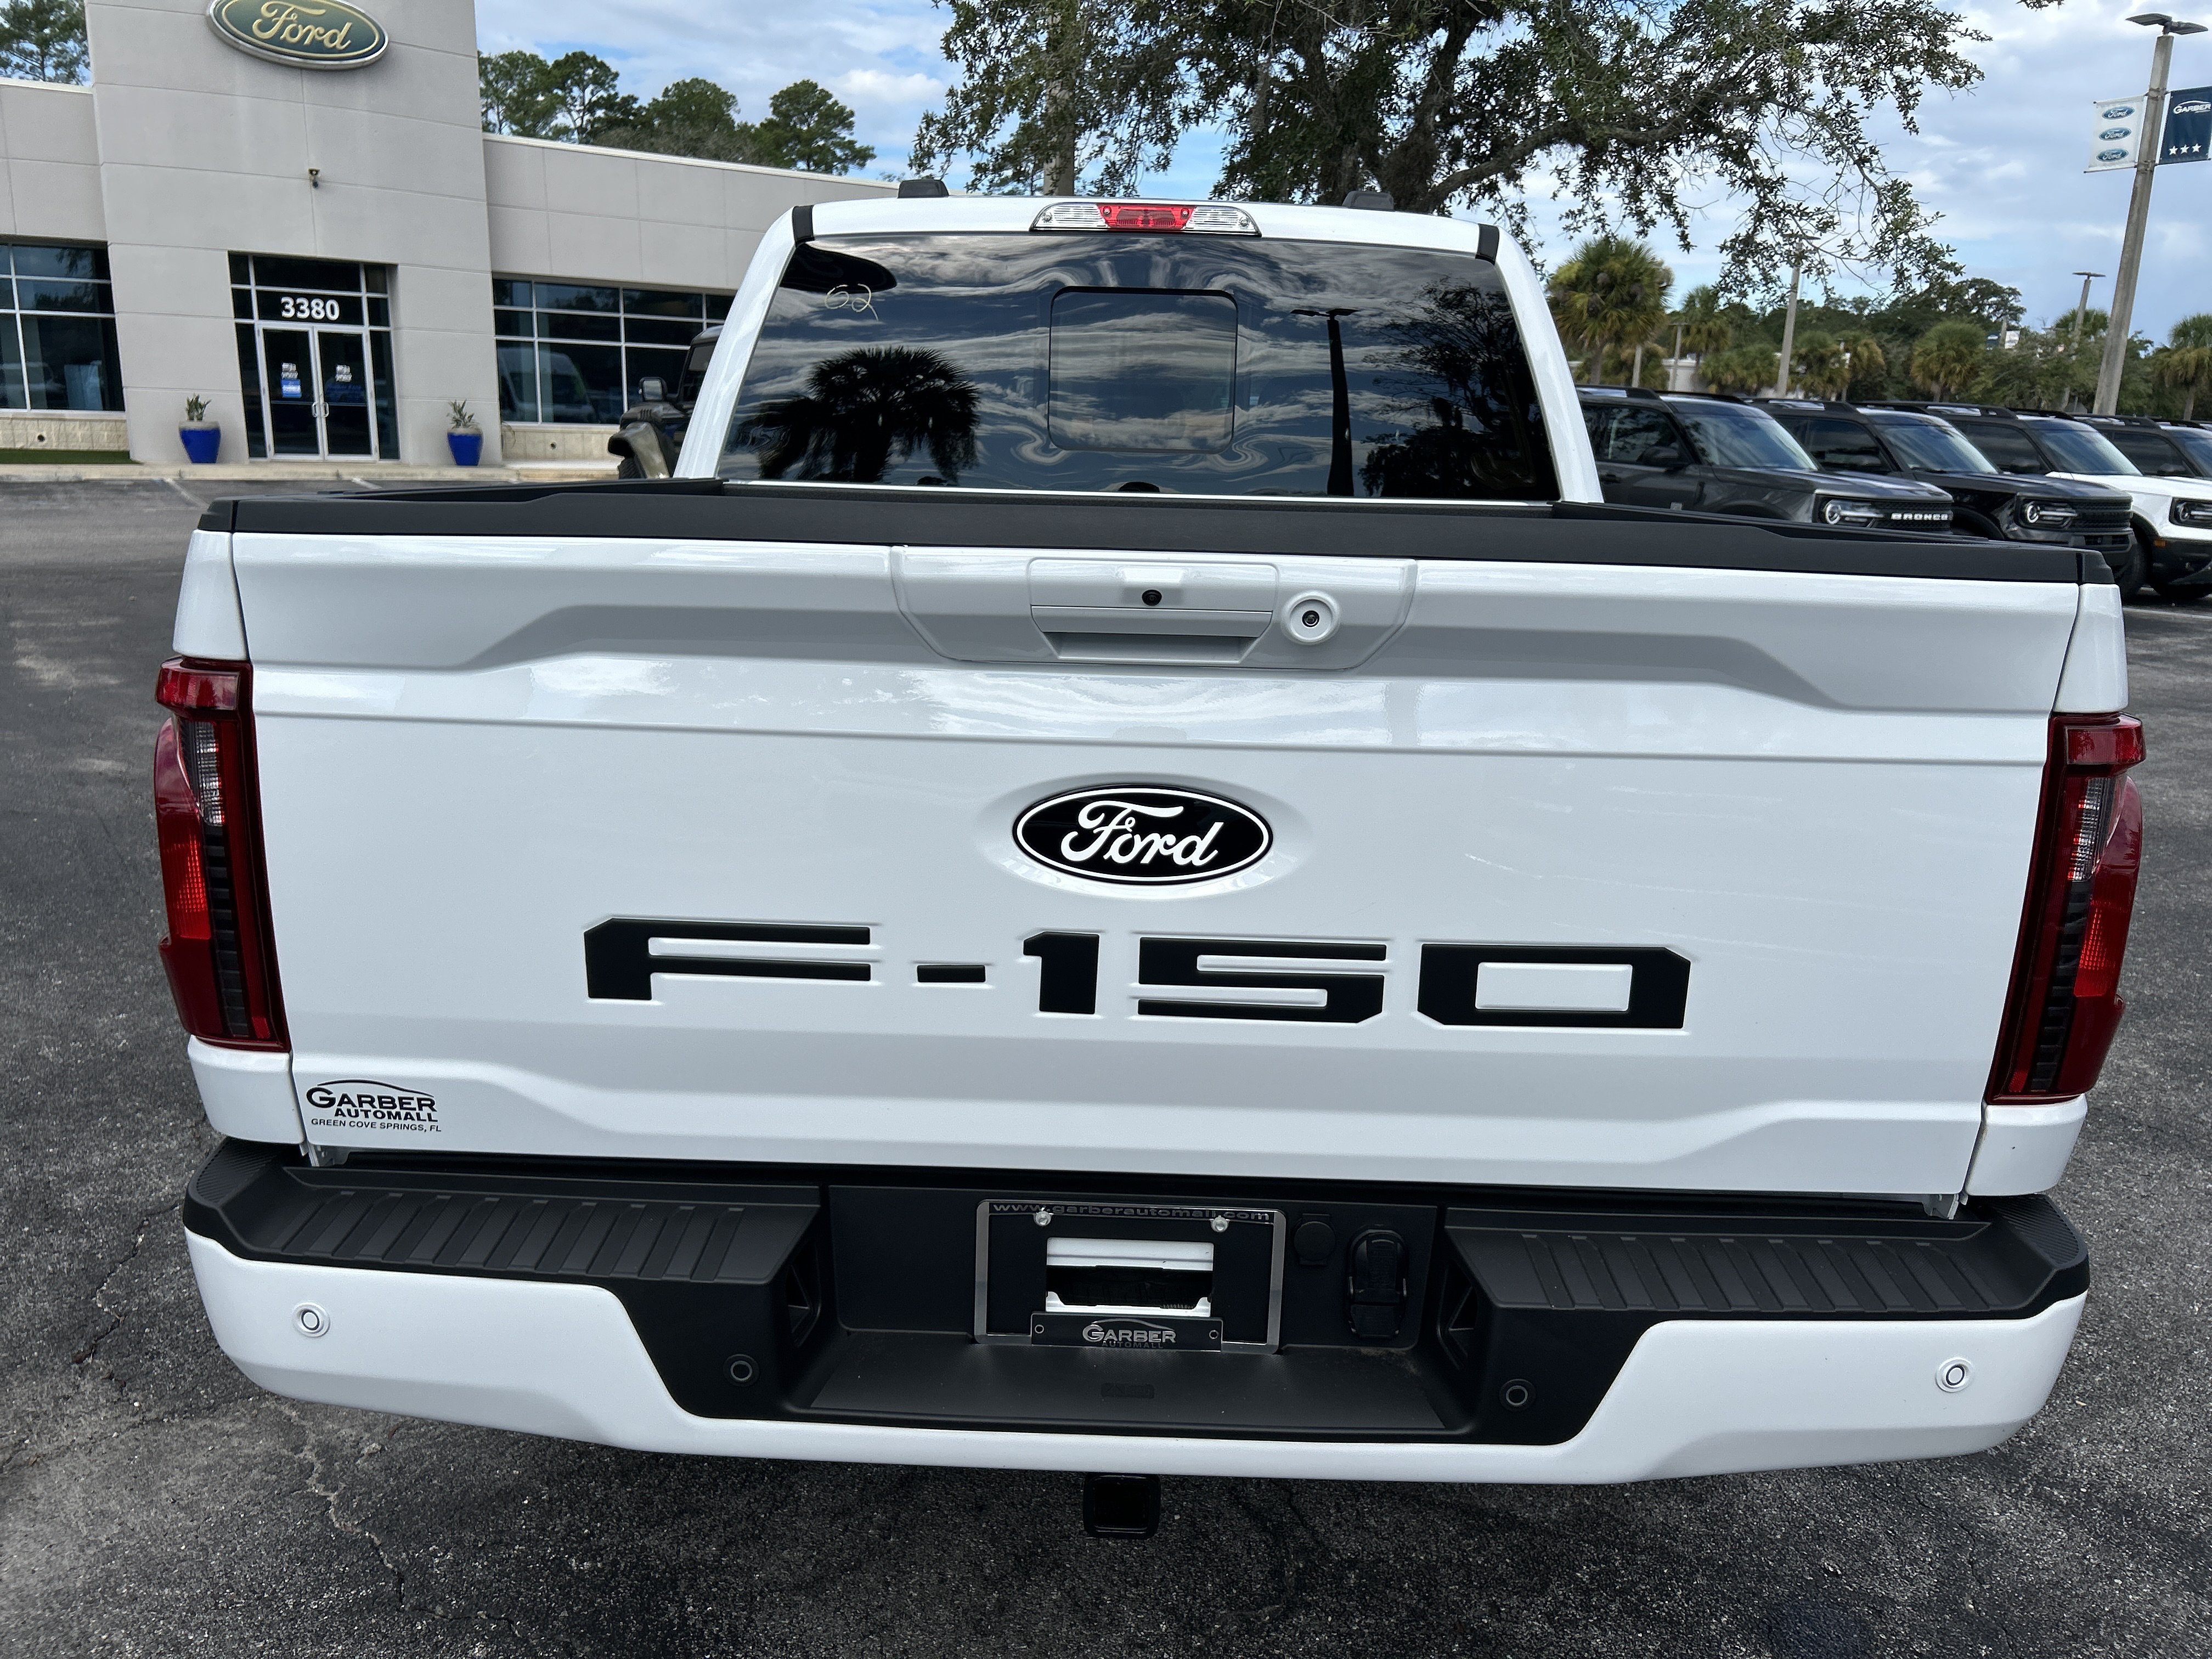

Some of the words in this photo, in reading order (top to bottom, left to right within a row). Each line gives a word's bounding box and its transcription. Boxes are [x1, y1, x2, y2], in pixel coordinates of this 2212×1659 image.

[252, 1, 353, 50] Ford
[2108, 107, 2128, 117] Ford
[2173, 104, 2211, 114] GARBER
[2104, 129, 2125, 139] Ford
[280, 297, 340, 320] 3380
[1060, 800, 1224, 867] Ford
[585, 917, 1692, 1029] F-150
[306, 1086, 437, 1111] GARBER
[334, 1108, 438, 1122] AUTOMALL
[311, 1118, 346, 1127] GREEN
[349, 1120, 376, 1128] COVE
[380, 1122, 427, 1132] SPRINGS,
[430, 1124, 442, 1132] FL
[1082, 1324, 1176, 1344] GARBER
[1101, 1341, 1164, 1350] AUTOMALL
